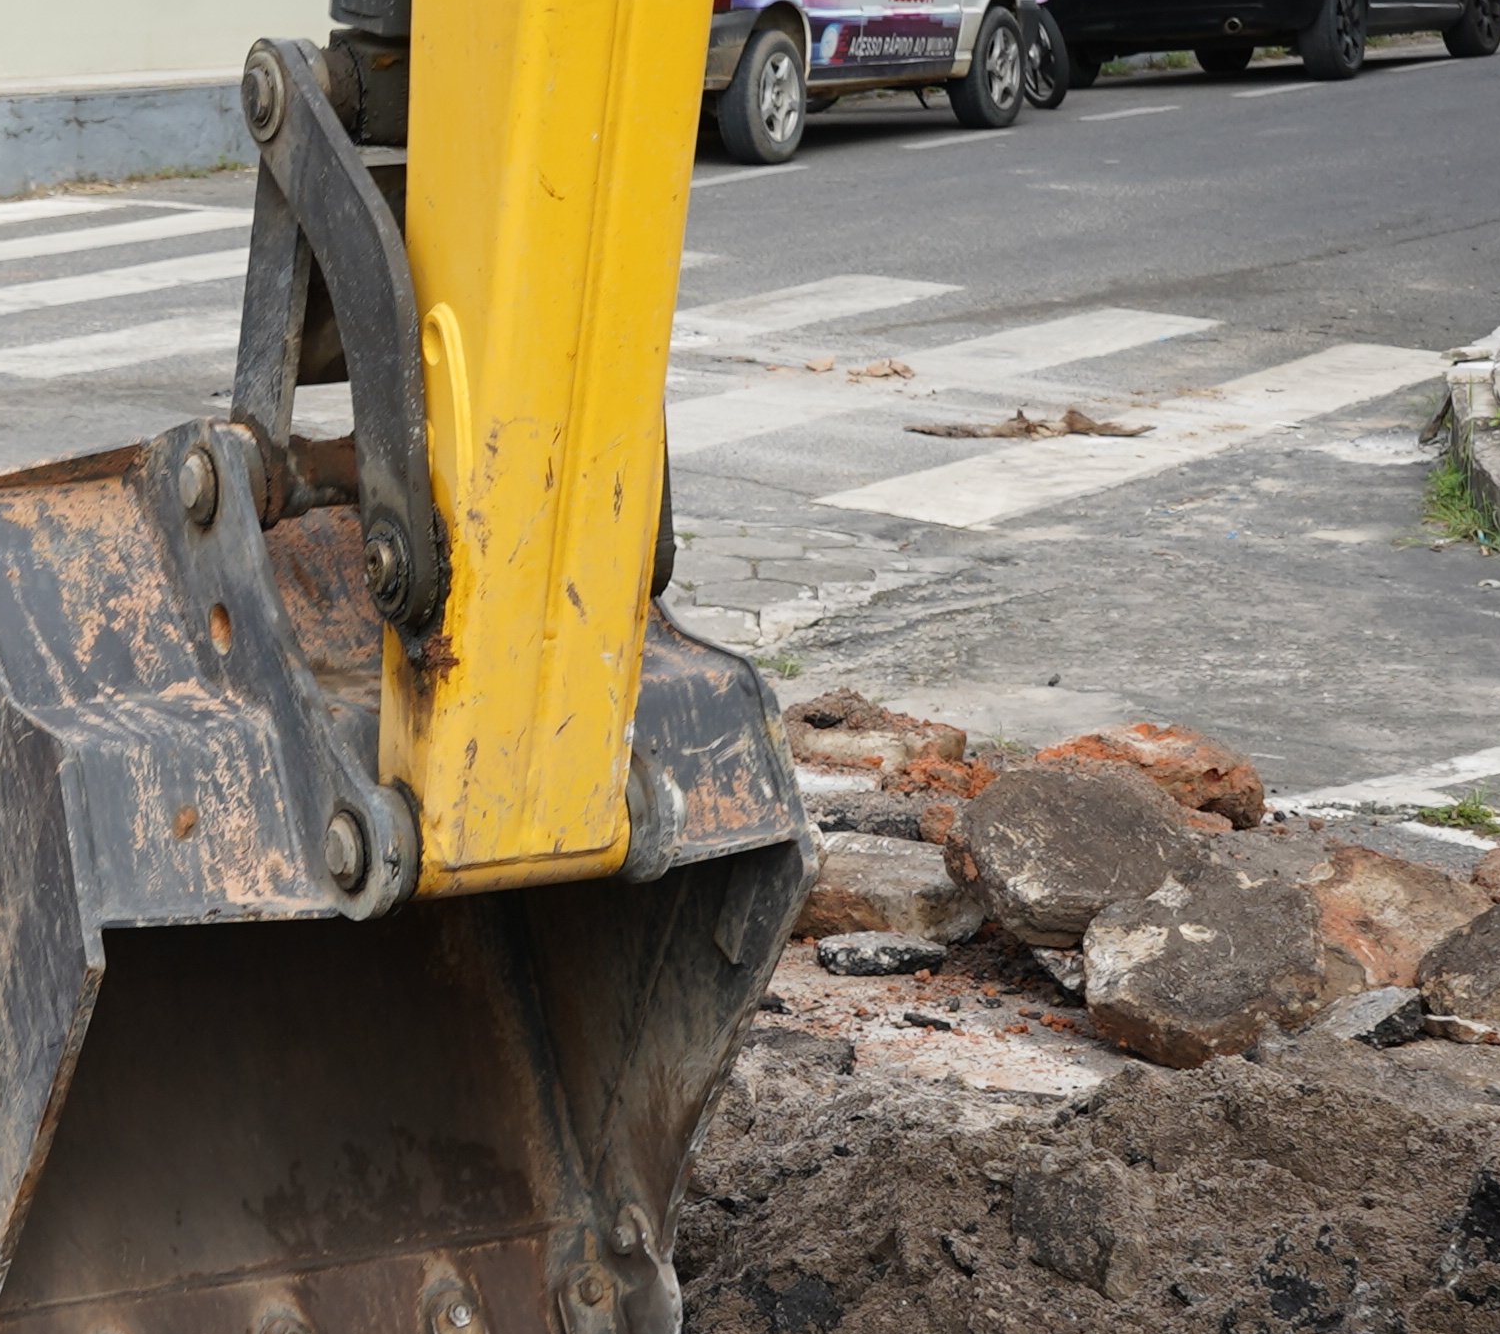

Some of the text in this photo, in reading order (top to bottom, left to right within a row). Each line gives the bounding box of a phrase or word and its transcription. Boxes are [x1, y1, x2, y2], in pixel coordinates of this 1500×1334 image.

[848, 36, 883, 57] ACESSO
[882, 31, 914, 56] RÁPIDO
[913, 36, 926, 56] AO
